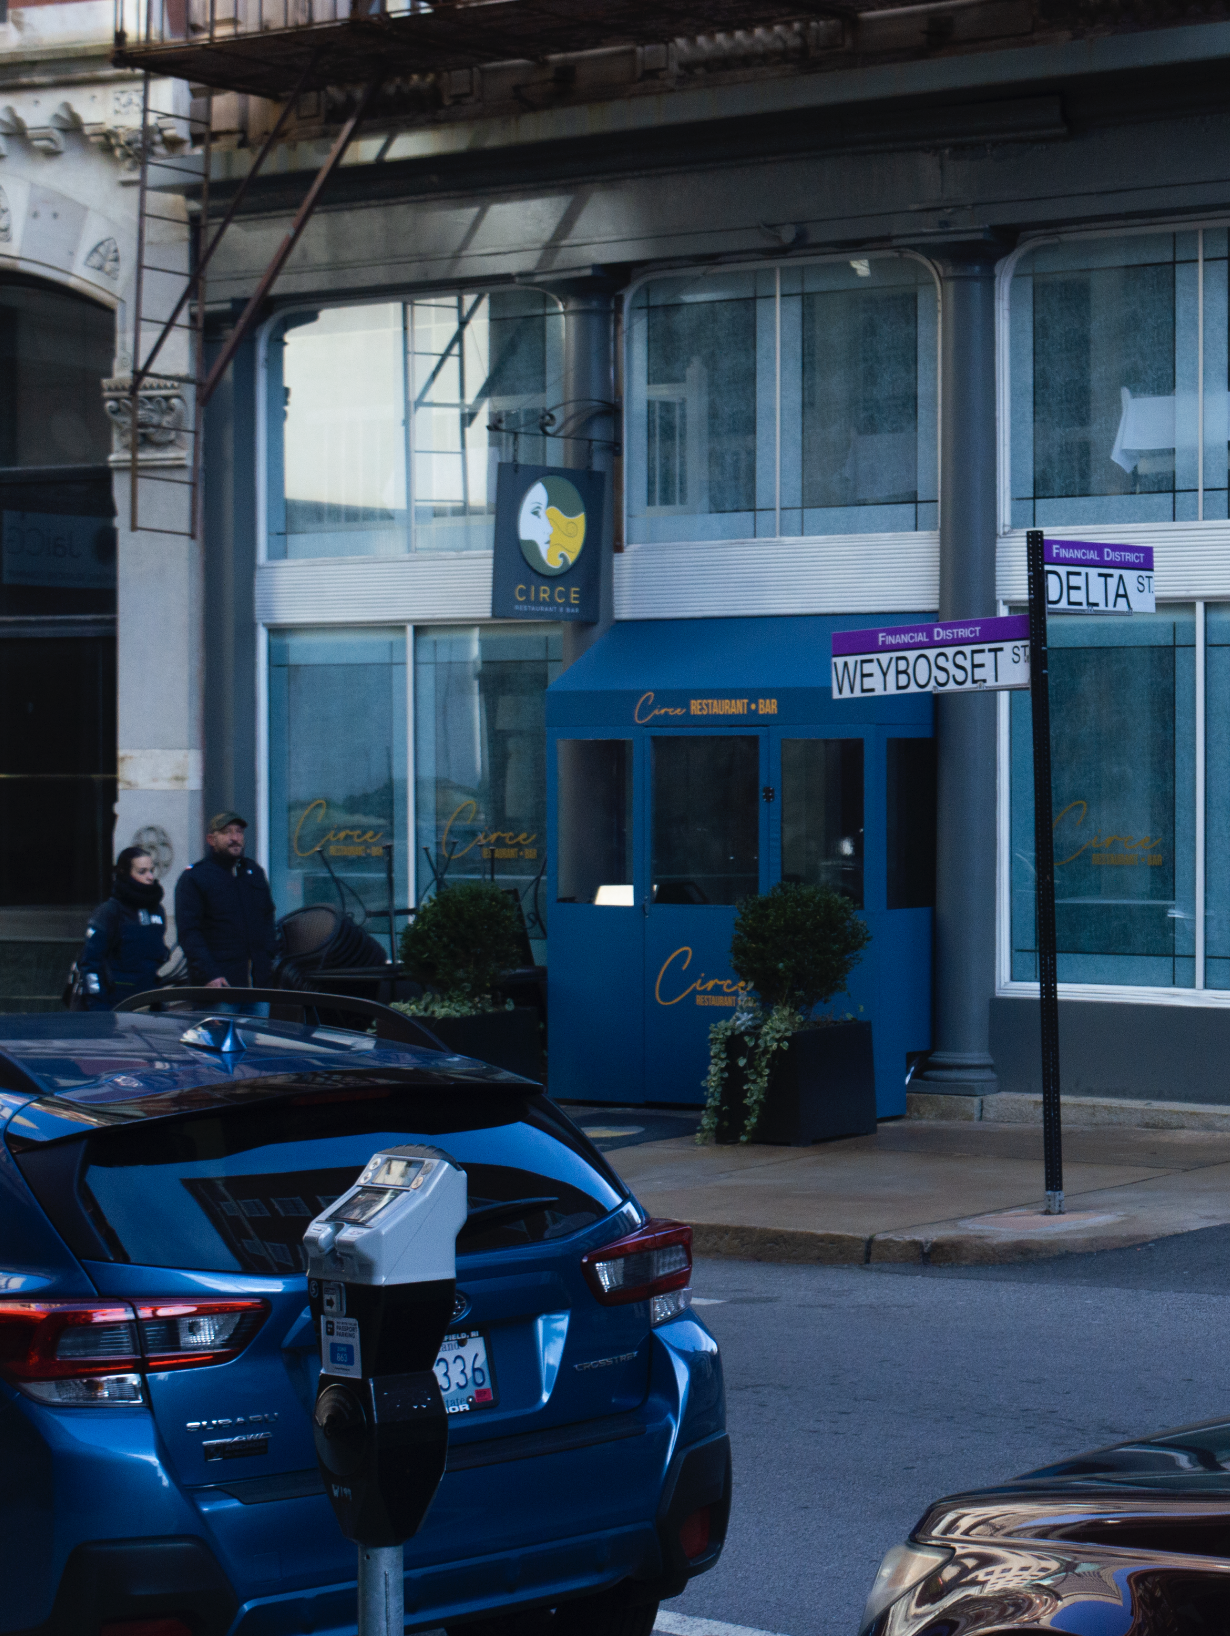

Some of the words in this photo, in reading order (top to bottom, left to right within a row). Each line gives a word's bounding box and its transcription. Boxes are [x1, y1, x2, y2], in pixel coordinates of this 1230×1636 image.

[1052, 544, 1100, 561] FINANCIAL
[1104, 548, 1145, 563] DISTRICT
[514, 585, 581, 604] CIRCE
[1046, 570, 1131, 609] DELTA
[514, 604, 557, 613] RESTAURANT
[878, 630, 929, 646] FINANCIAL
[933, 626, 981, 641] DISTRICT
[833, 647, 1004, 696] WEYBOSSET
[634, 691, 686, 724] Circe
[690, 698, 749, 715] RESTAURANT
[758, 698, 777, 715] BAR
[293, 799, 384, 857] Circe
[441, 800, 537, 859] Circe
[1052, 800, 1162, 866] Circe
[1091, 853, 1139, 866] RESTAURANT
[1147, 854, 1163, 867] BAR
[655, 946, 750, 1006] Circe
[696, 995, 737, 1008] RESTAURANT
[573, 1350, 639, 1372] CROSSTREK
[186, 1412, 279, 1432] SUBARU
